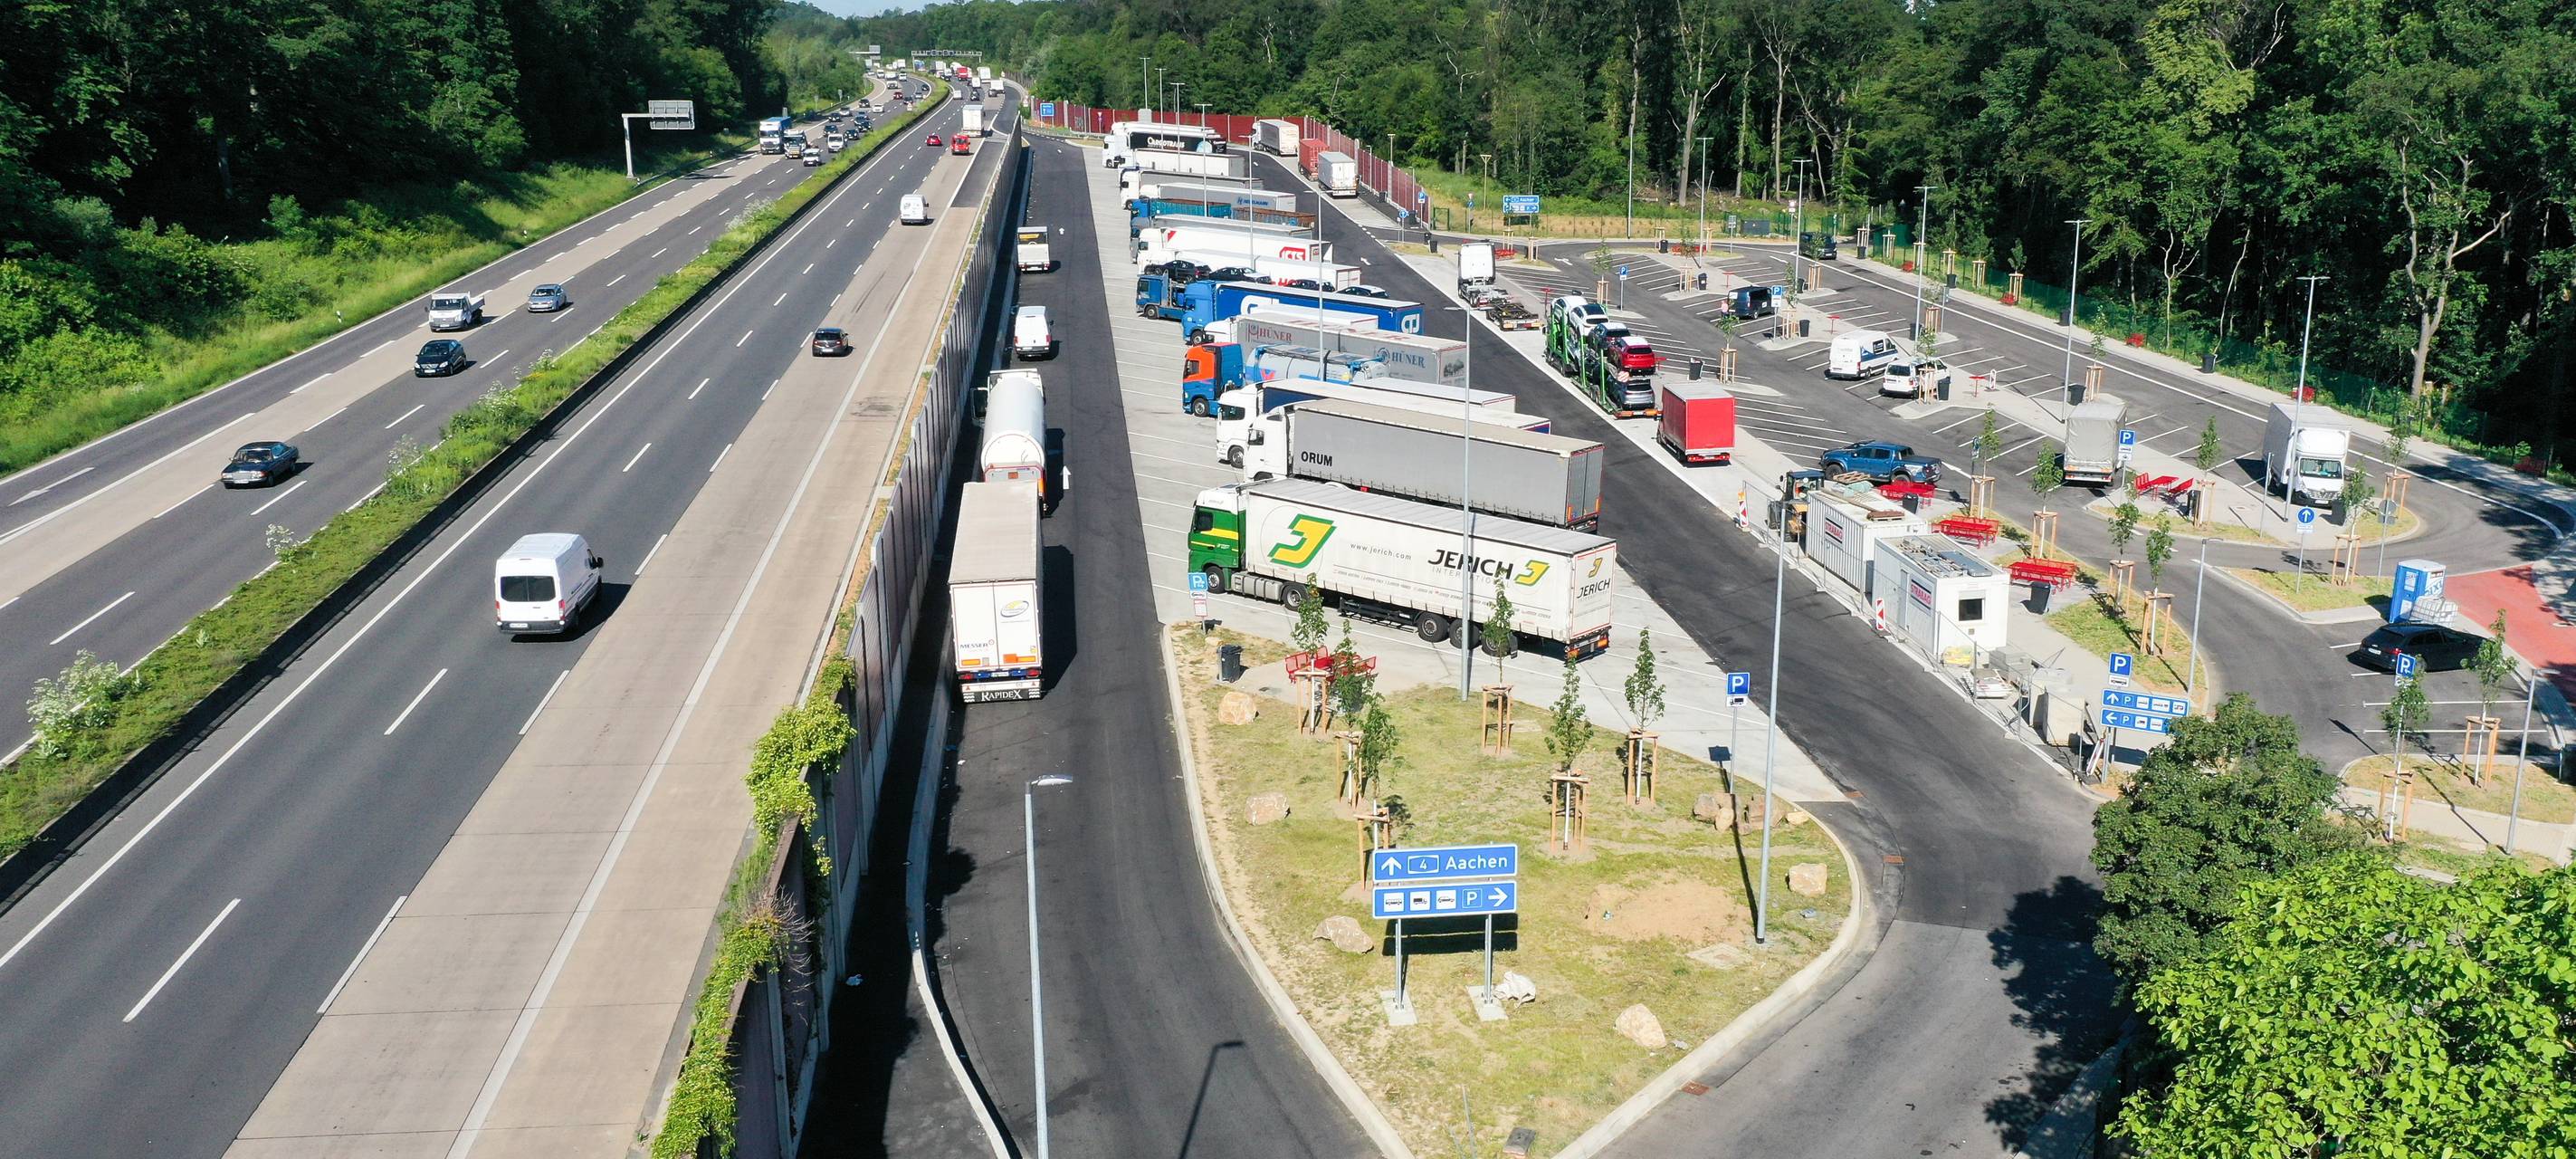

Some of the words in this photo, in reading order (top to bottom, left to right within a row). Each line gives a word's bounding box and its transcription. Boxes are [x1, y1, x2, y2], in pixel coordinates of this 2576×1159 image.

[1259, 325, 1292, 341] HÜNER
[1392, 350, 1426, 369] HÜNER
[2123, 432, 2132, 444] P
[1301, 451, 1332, 467] ORUM
[1825, 521, 1843, 541] STRABAG
[1350, 542, 1412, 560] www.jerich.com
[1577, 578, 1611, 599] JERICH
[1910, 583, 1932, 606] STRABAG
[2113, 656, 2127, 673] P
[2400, 657, 2410, 674] P
[1732, 675, 1744, 693] P
[2123, 695, 2131, 705] P
[2122, 715, 2130, 724] P
[1419, 858, 1427, 870] 4
[1445, 855, 1507, 870] Aachen
[1466, 891, 1477, 906] P
